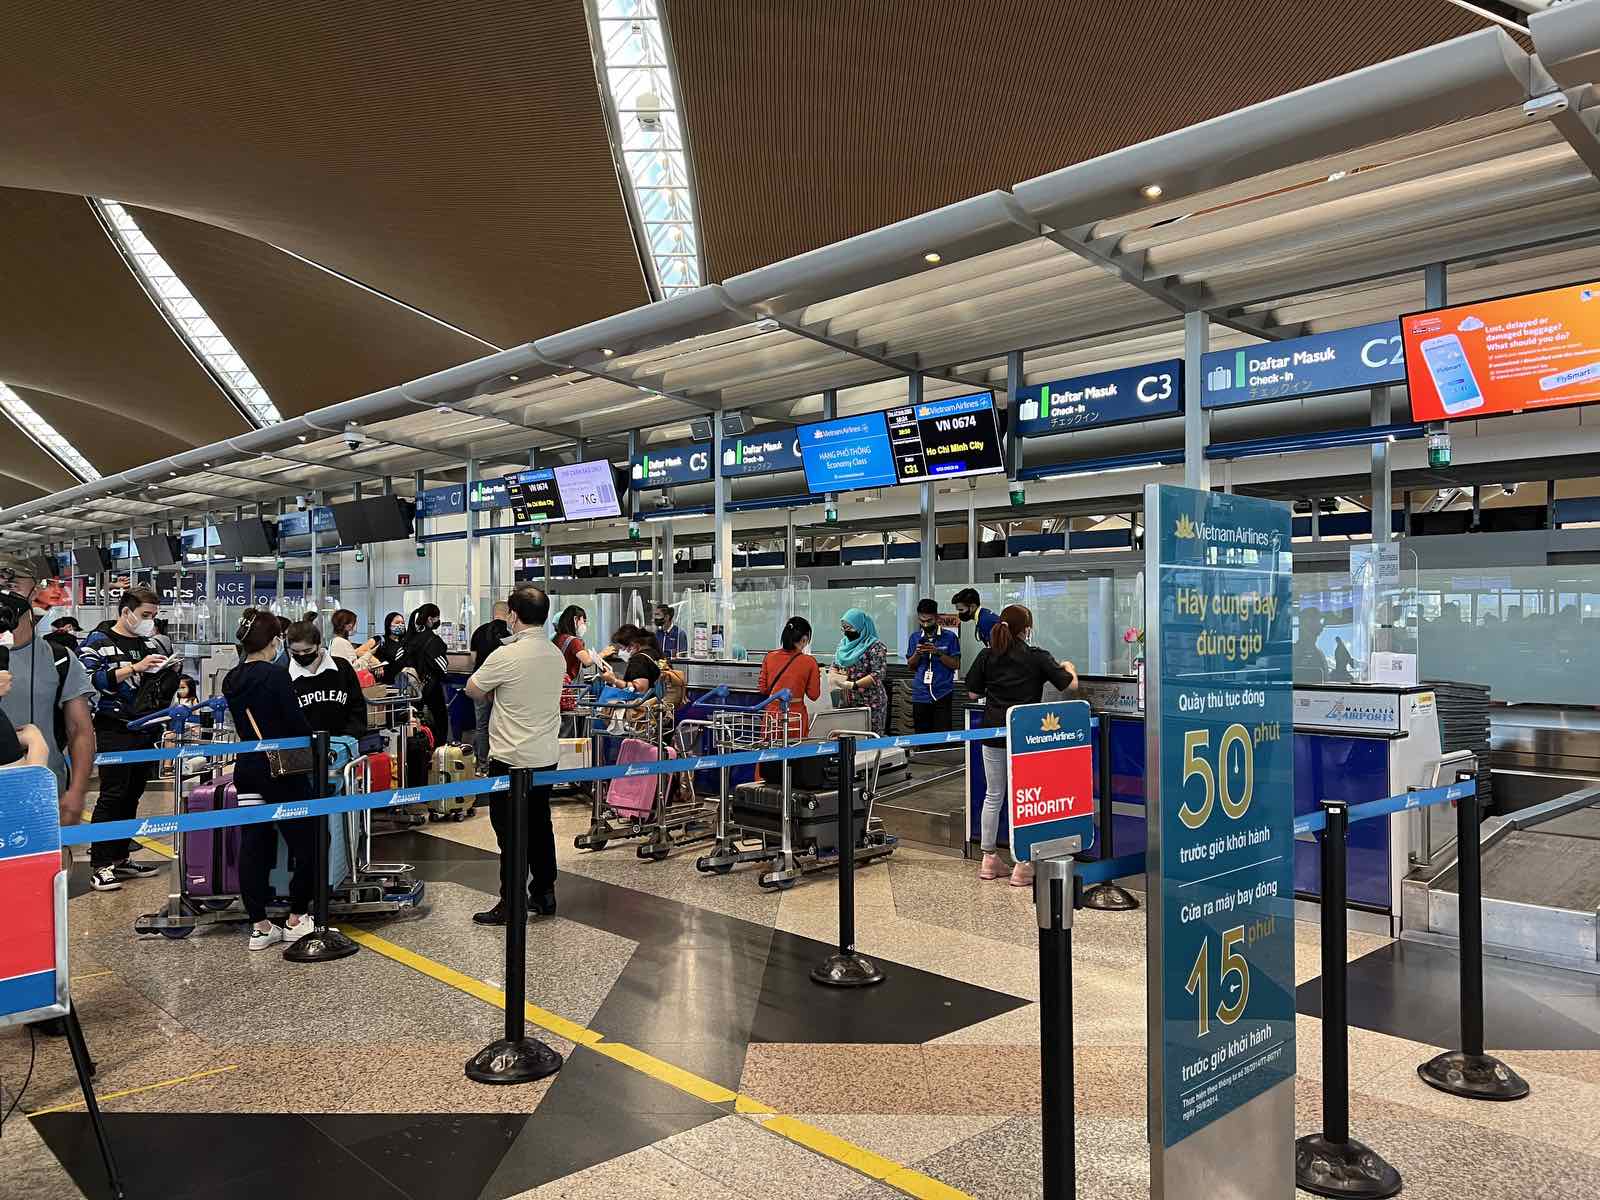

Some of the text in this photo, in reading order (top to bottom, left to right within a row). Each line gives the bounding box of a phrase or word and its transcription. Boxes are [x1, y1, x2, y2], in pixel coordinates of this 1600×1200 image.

[1249, 347, 1336, 373] Daftar Masuk
[1051, 384, 1118, 405] Daftar Masuk
[1136, 374, 1172, 403] C3
[936, 416, 977, 432] VN 0674
[1050, 411, 1099, 428] チェックイン
[743, 440, 783, 454] Daftar Masuk
[926, 440, 984, 456] Ho Chi Minh City
[689, 453, 708, 471] C5
[450, 491, 462, 506] C7
[1177, 588, 1208, 621] Hãy
[1252, 591, 1278, 621] bay
[1196, 629, 1238, 661] đúng
[1225, 691, 1241, 711] tục
[1242, 689, 1265, 708] đóng
[1343, 711, 1394, 721] AIRPORTS
[1178, 720, 1281, 830] 50 phút
[1016, 786, 1042, 805] SKY
[1016, 797, 1075, 820] PRIORITY
[1180, 842, 1208, 864] trước
[1248, 826, 1270, 846] hành
[1203, 900, 1214, 917] ra
[1215, 892, 1236, 915] máy
[1237, 888, 1254, 907] bay
[1255, 880, 1278, 898] đóng
[1184, 913, 1276, 1038] 15 phút
[1181, 1055, 1209, 1082] trước
[1249, 1023, 1272, 1045] hành
